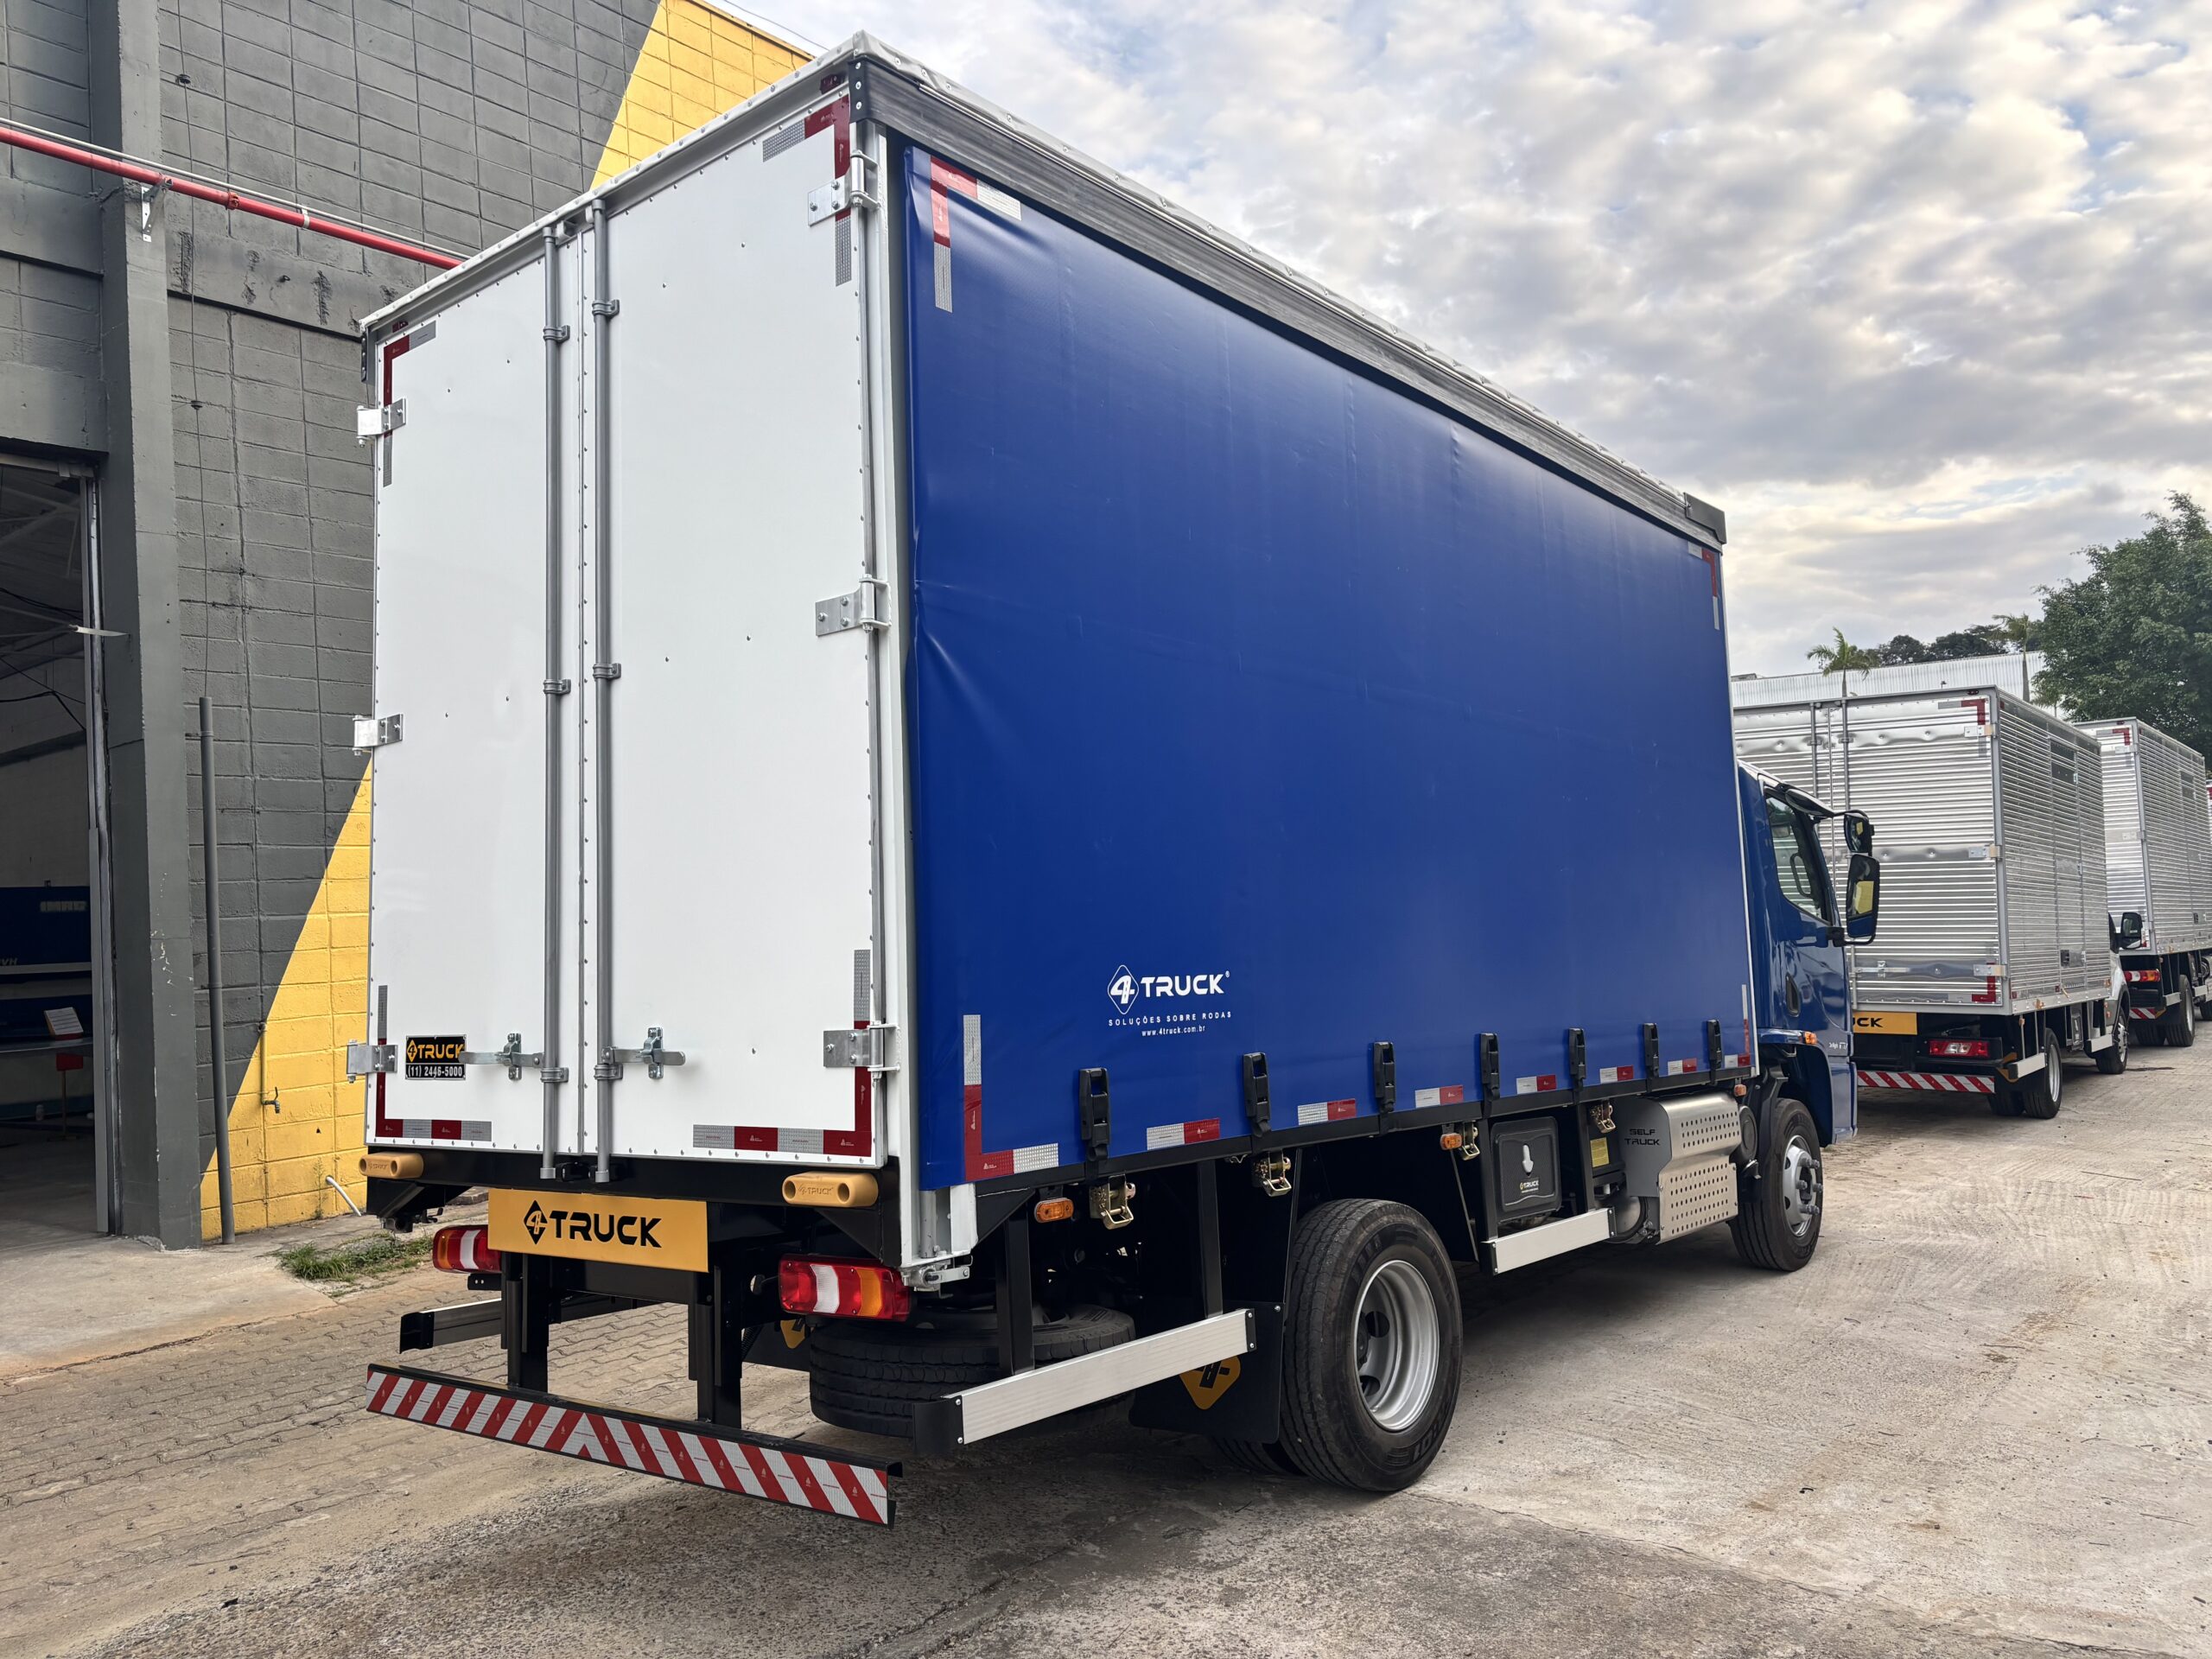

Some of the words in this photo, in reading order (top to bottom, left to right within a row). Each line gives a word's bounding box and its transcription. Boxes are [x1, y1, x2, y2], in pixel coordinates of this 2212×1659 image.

[1109, 1015, 1161, 1027] SOLUÇÕES
[1166, 1013, 1197, 1023] SOBRE
[1202, 1011, 1231, 1020] RODAS
[1141, 1025, 1206, 1037] www.4truck.com.br
[408, 1066, 422, 1077] (11)
[424, 1065, 463, 1077] 2446-5000
[1624, 1137, 1660, 1146] TRUCK
